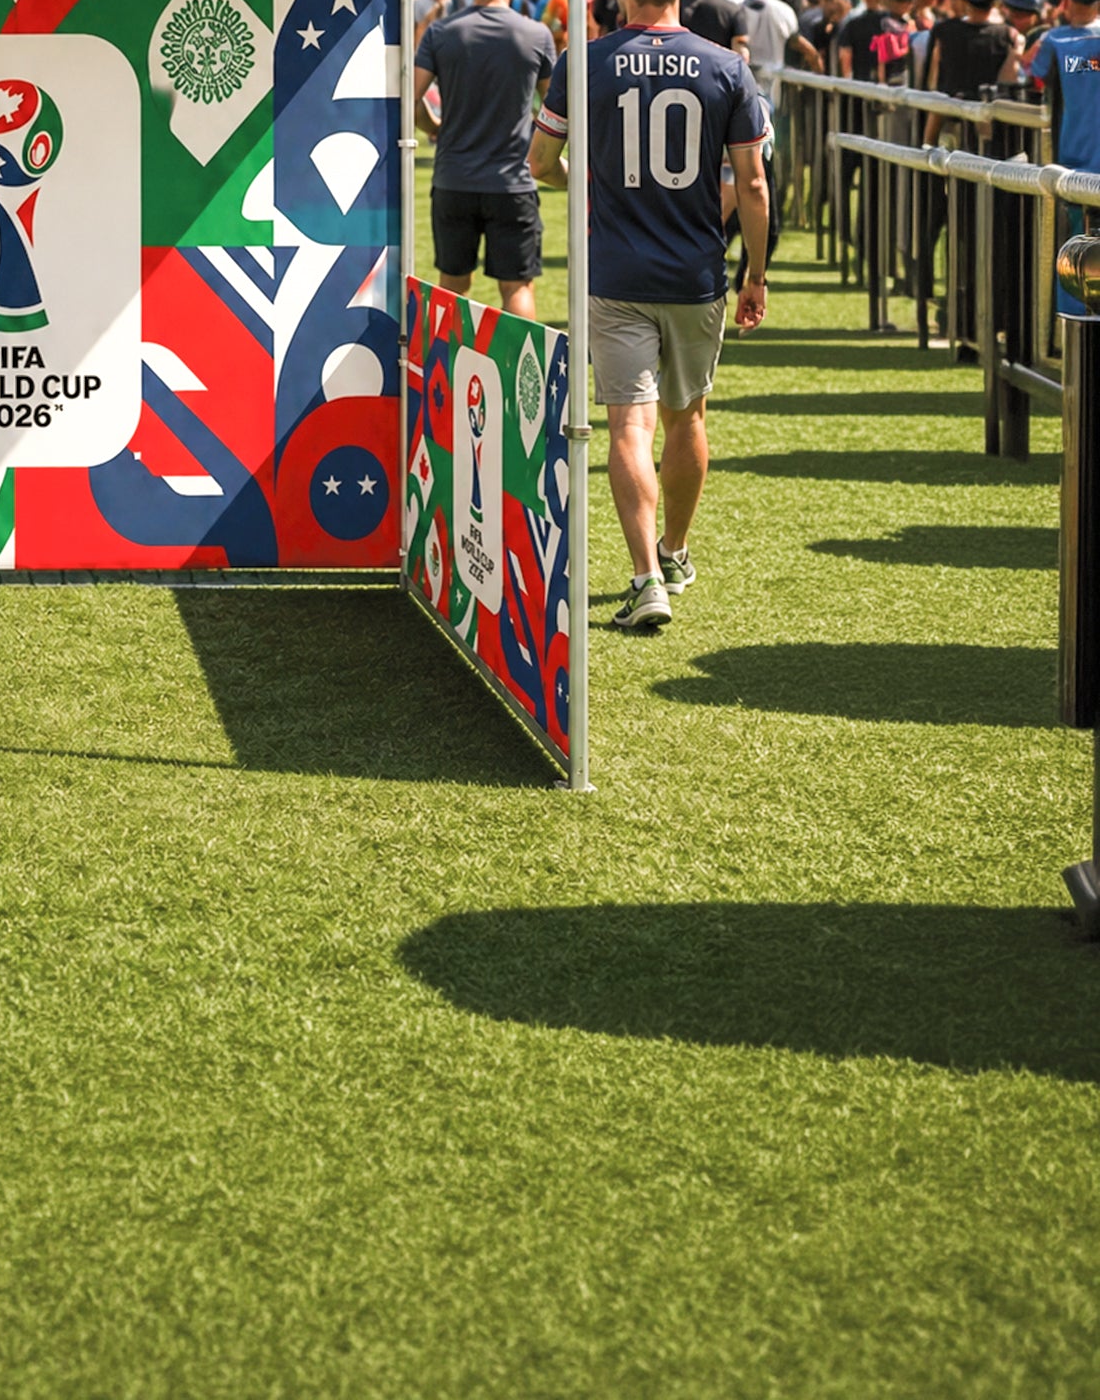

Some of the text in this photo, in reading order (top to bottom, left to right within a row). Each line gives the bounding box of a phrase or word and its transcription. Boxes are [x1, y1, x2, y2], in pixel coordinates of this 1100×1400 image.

[614, 53, 701, 78] PULISIC
[617, 87, 703, 190] 10
[41, 374, 102, 400] CUP
